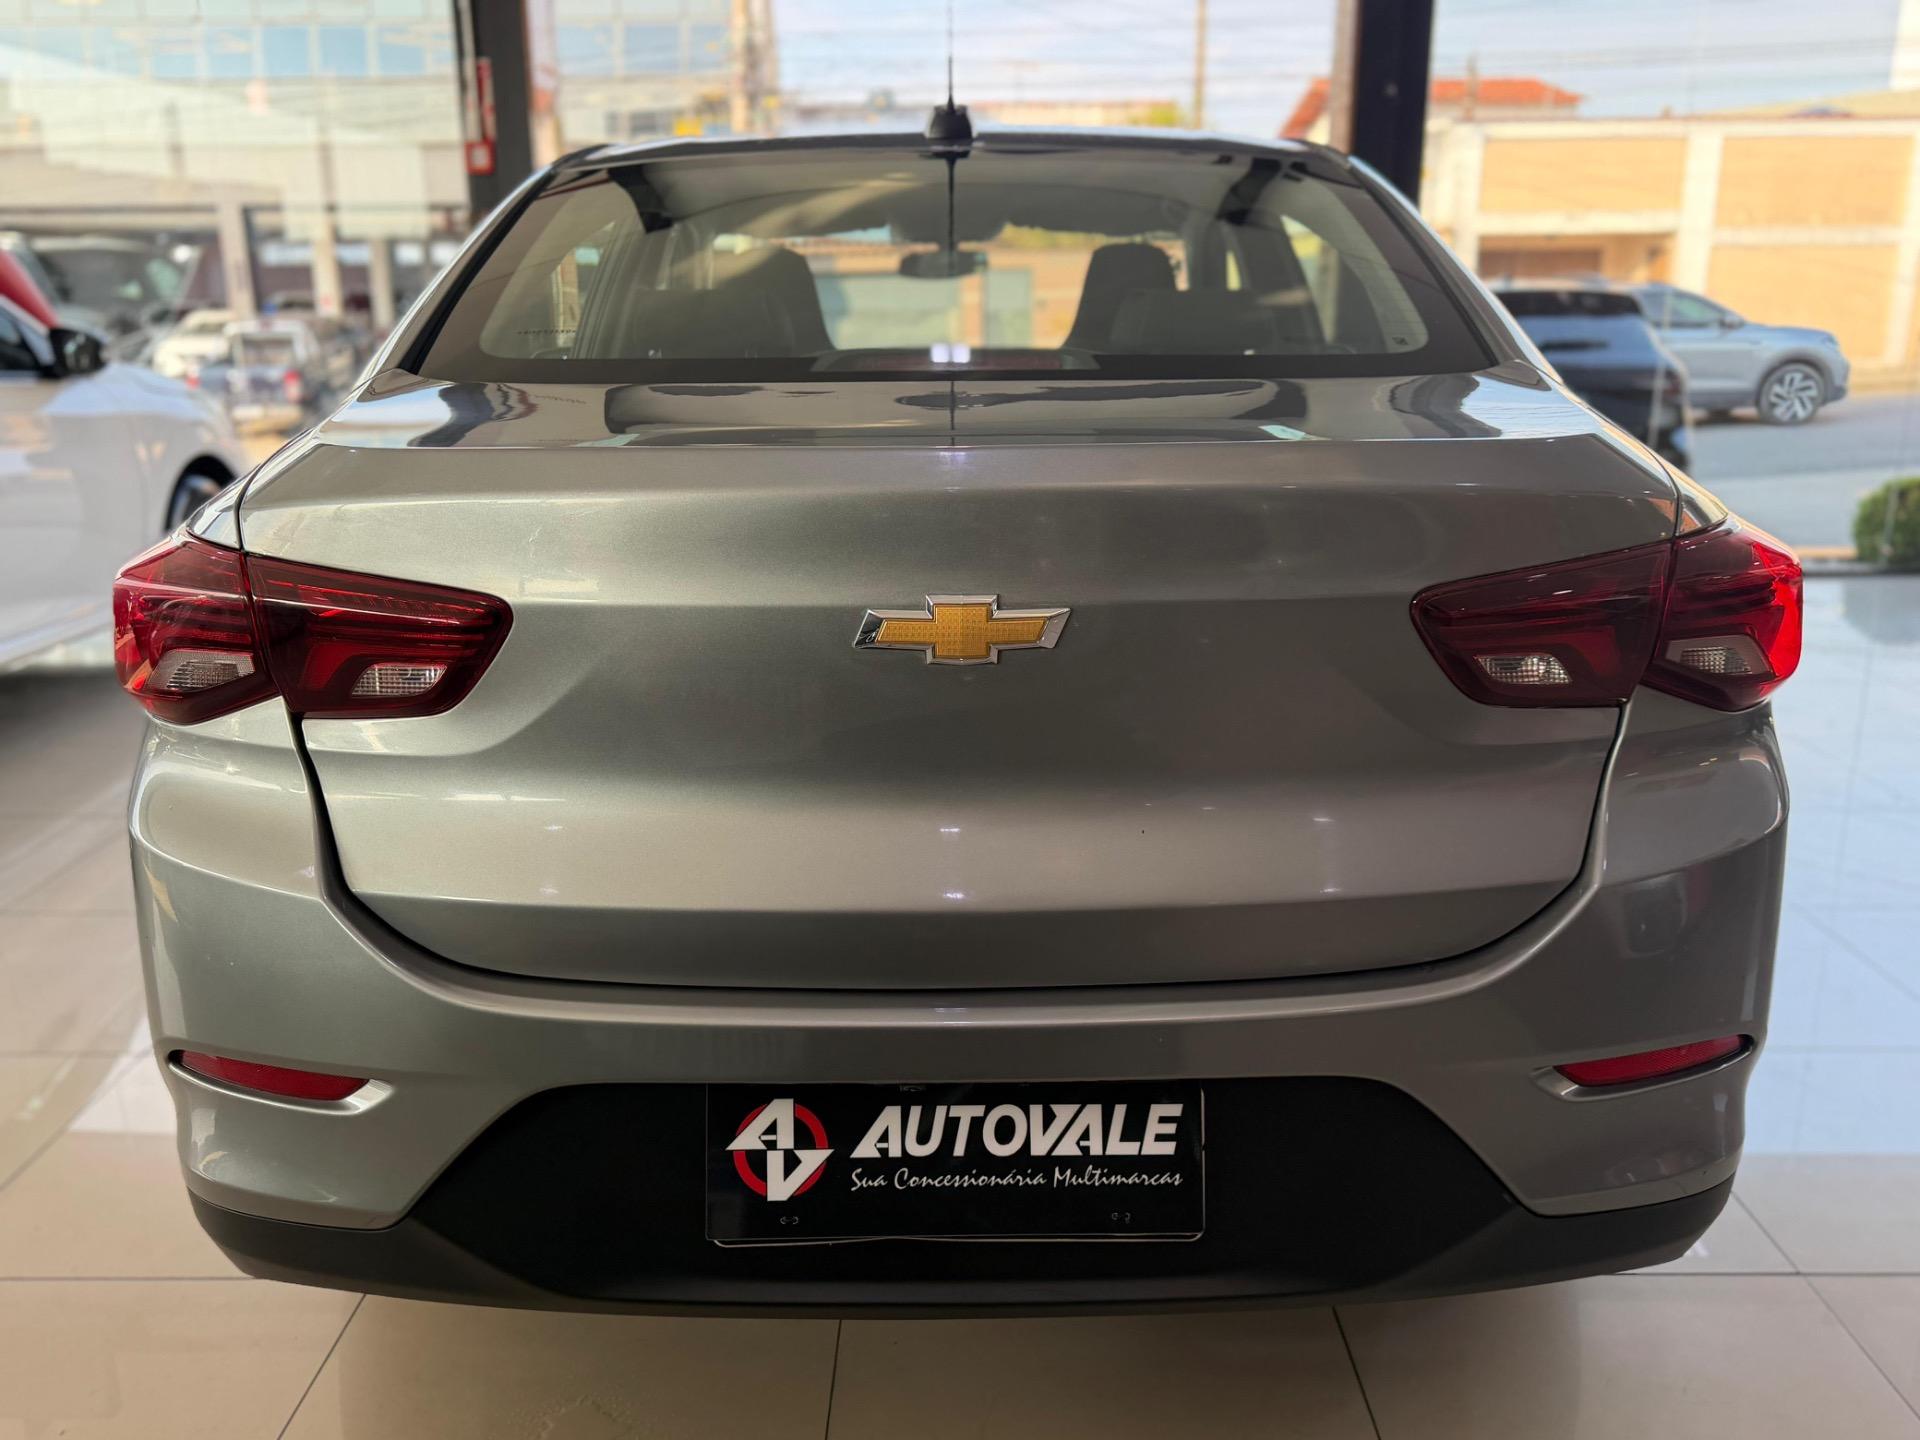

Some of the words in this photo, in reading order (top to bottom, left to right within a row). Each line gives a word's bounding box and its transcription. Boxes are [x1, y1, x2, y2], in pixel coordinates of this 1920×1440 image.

[850, 1103, 1183, 1158] AUTOVALE
[850, 1167, 888, 1191] Sua
[894, 1167, 1047, 1190] Concessionária
[1053, 1165, 1183, 1188] Multimarcas
